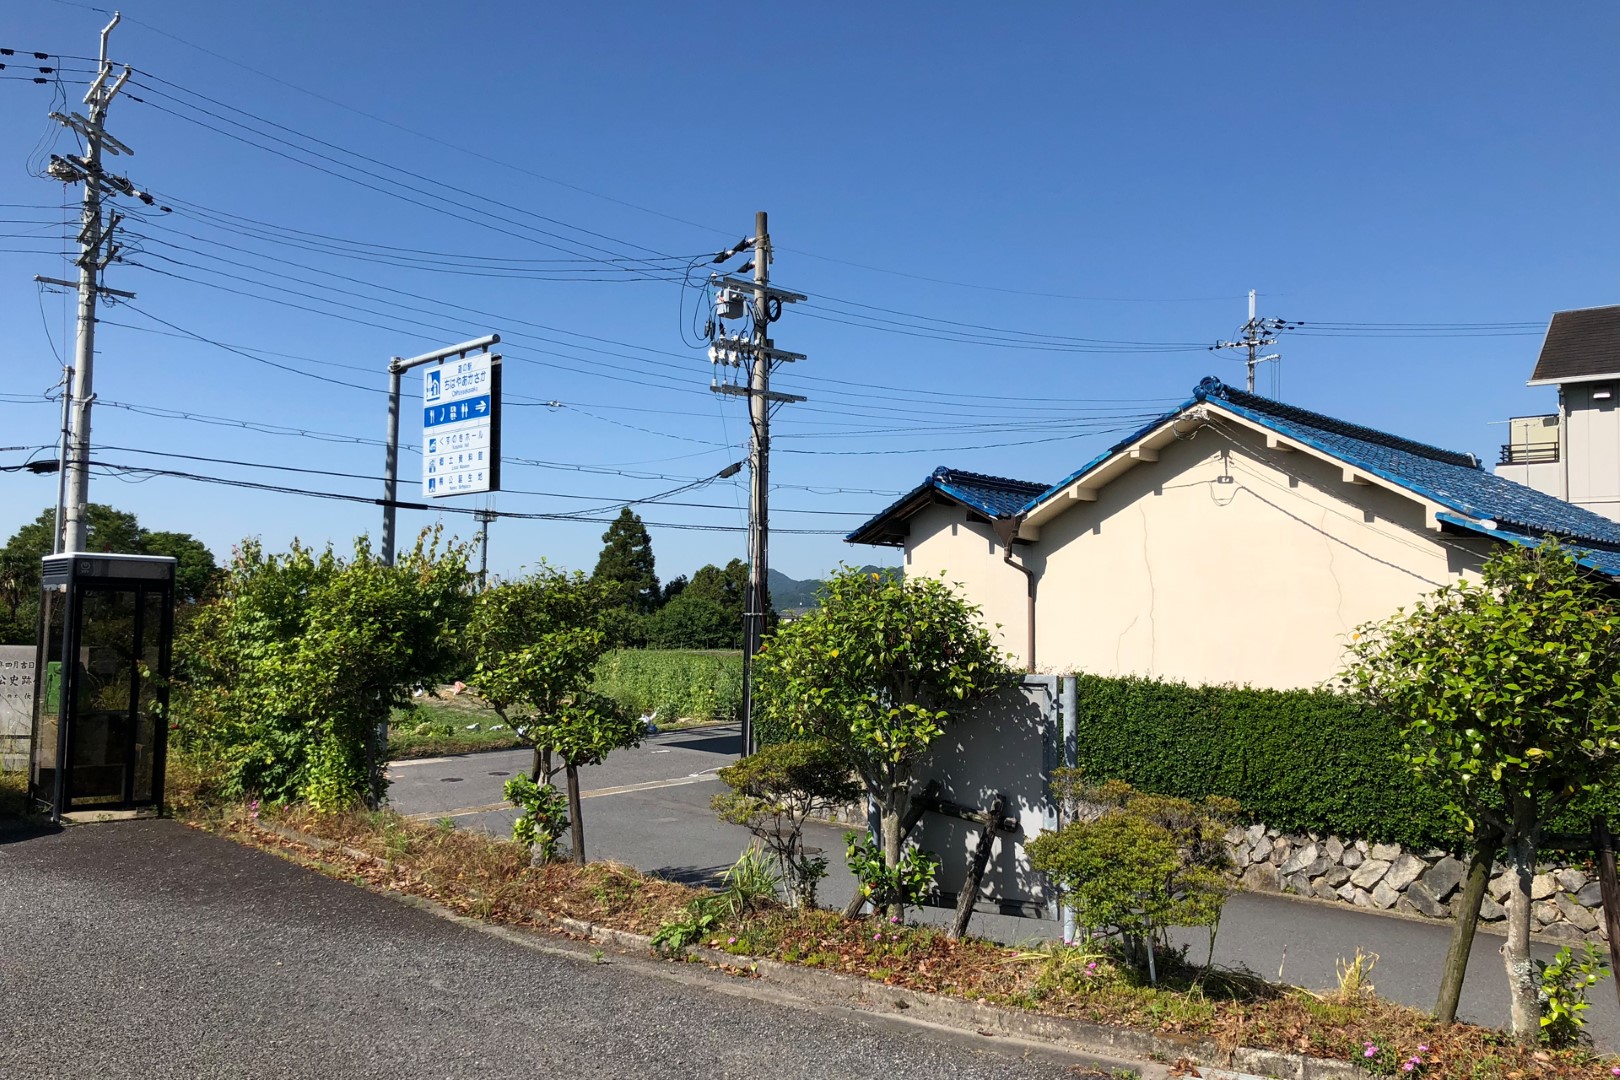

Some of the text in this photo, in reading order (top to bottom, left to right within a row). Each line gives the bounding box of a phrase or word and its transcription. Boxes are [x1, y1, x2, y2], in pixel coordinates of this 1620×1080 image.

[458, 362, 472, 374] 道の駅
[444, 371, 487, 391] ちはやあかさか
[440, 430, 483, 446] くすのきホール
[0, 674, 35, 686] 公史跡
